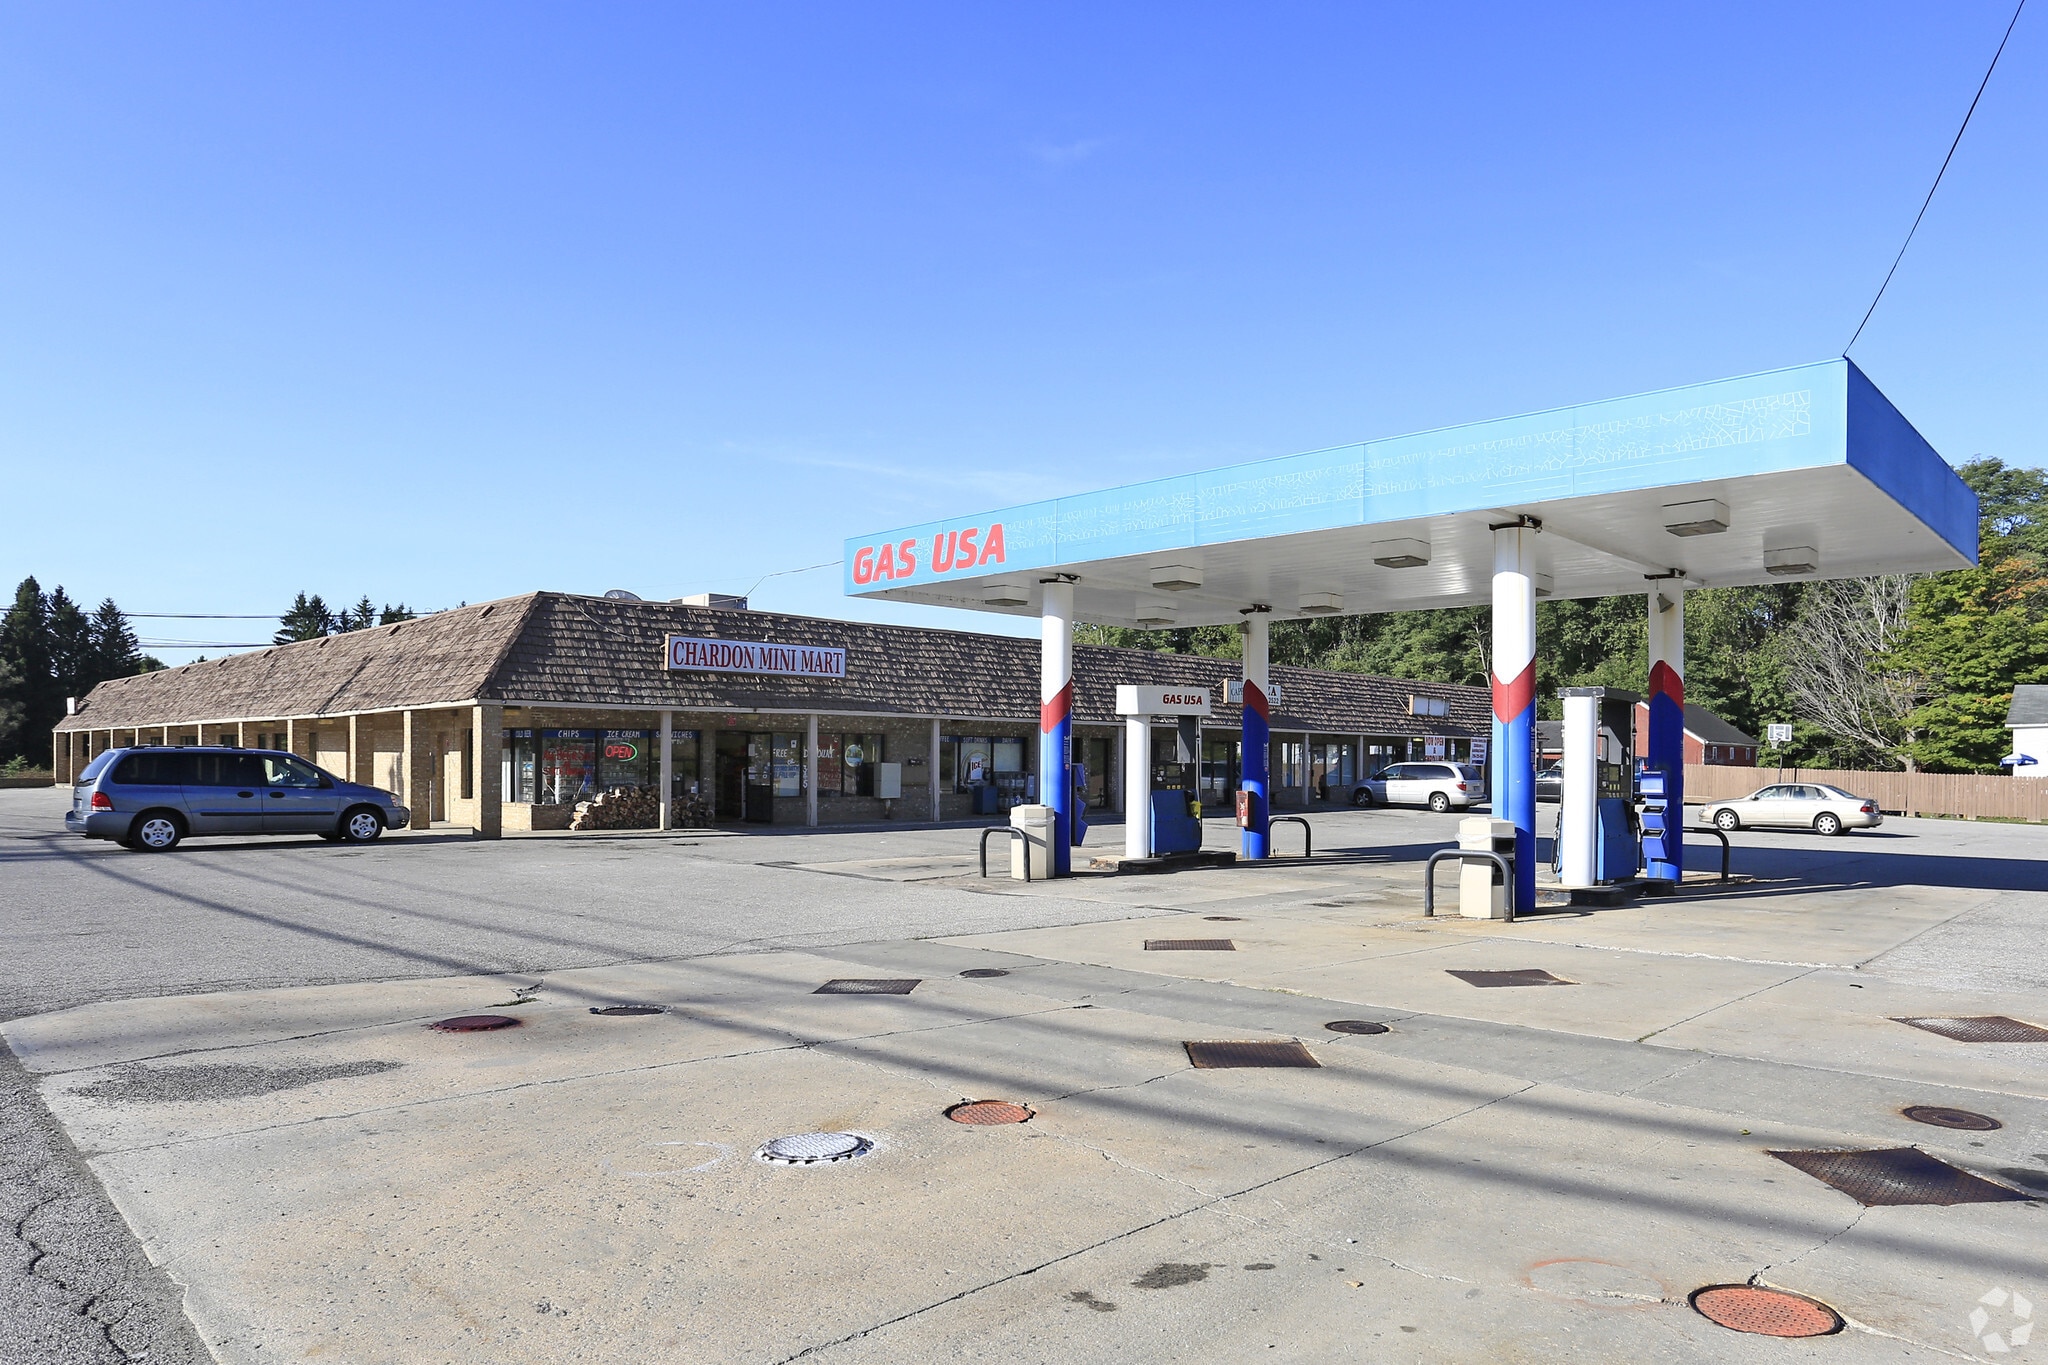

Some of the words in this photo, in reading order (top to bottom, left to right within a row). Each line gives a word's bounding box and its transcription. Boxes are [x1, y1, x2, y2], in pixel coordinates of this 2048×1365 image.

[853, 538, 917, 585] GAS
[931, 523, 1006, 573] USA
[673, 641, 755, 670] CHARDON
[759, 647, 797, 671] MINI
[800, 650, 843, 674] MART
[1162, 694, 1182, 705] GAS
[1184, 695, 1203, 705] USA
[558, 730, 580, 738] CHIPS
[606, 730, 619, 738] ICE
[605, 745, 633, 758] OPEN
